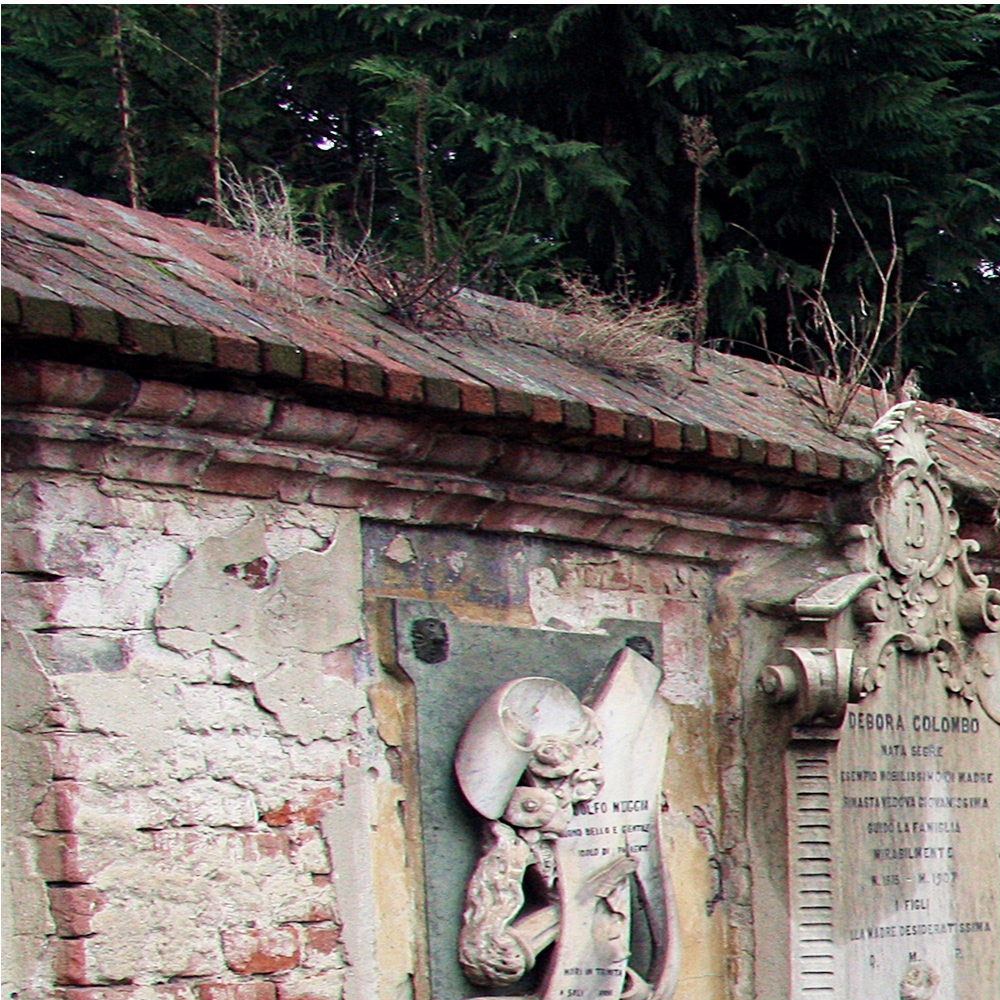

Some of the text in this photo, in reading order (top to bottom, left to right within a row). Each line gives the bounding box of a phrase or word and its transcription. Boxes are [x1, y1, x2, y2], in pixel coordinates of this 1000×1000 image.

[848, 711, 980, 734] DEBORA COLOMBO
[958, 771, 993, 784] MADRE
[913, 821, 961, 834] FAMIGLIA
[904, 899, 929, 911] FIGLI
